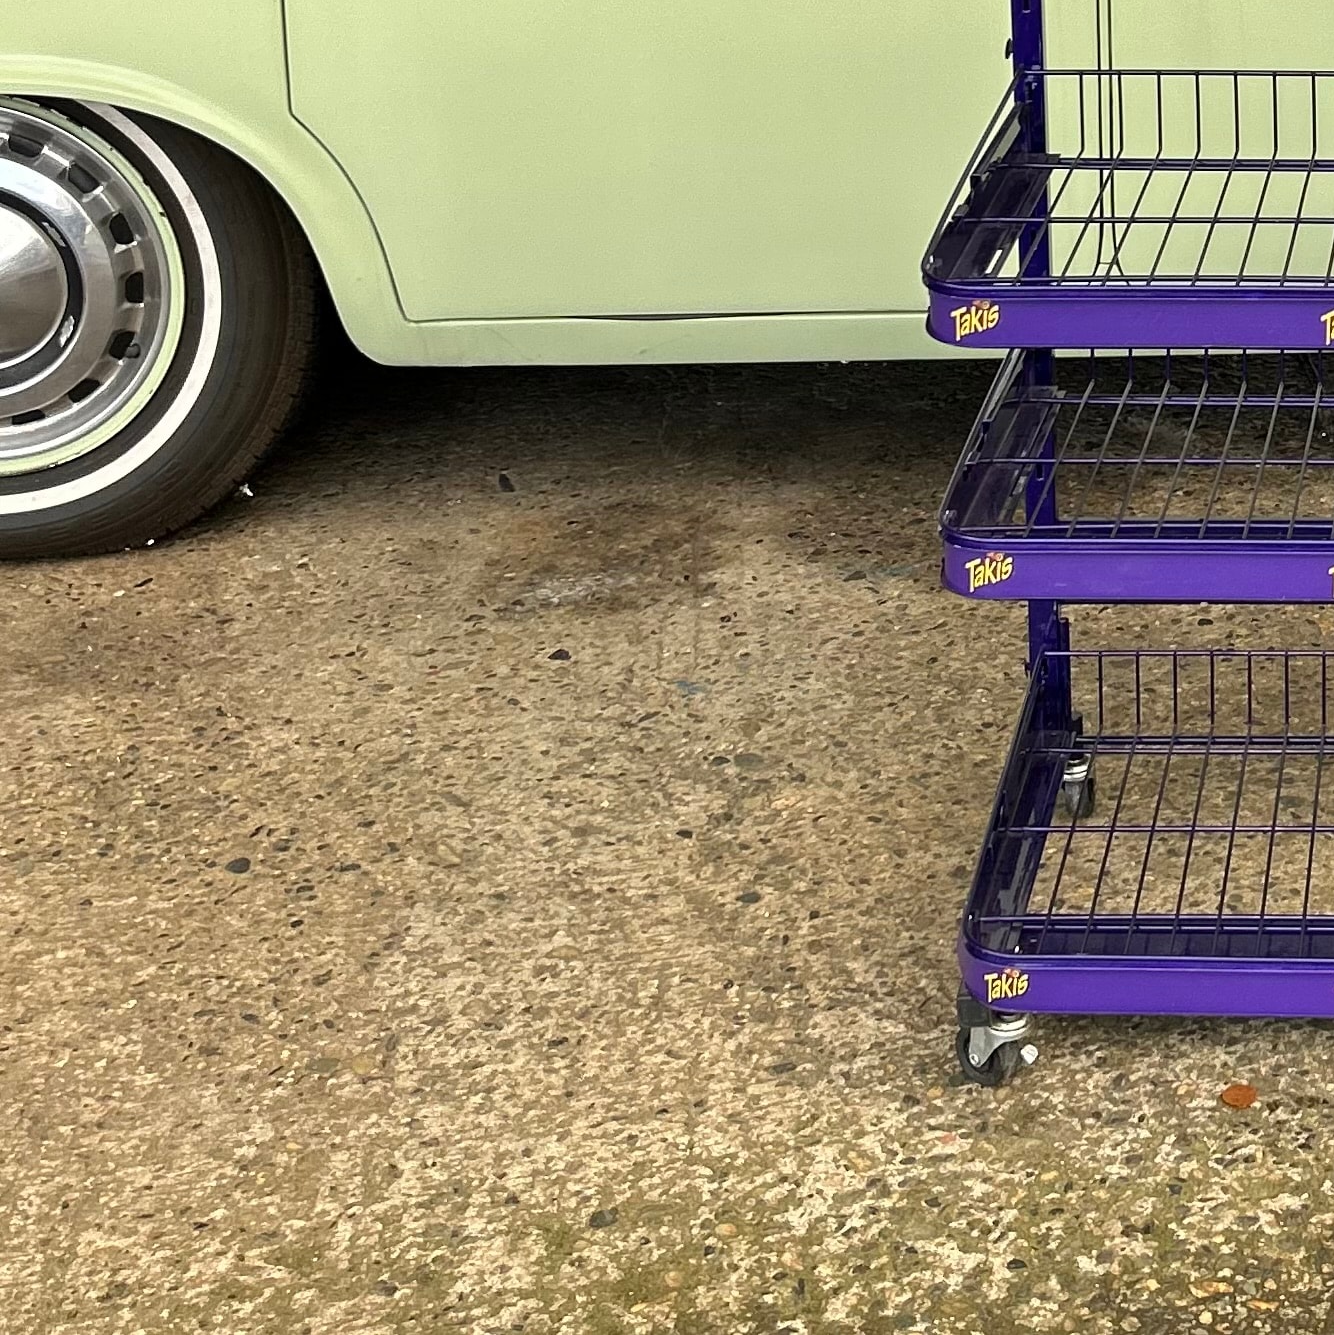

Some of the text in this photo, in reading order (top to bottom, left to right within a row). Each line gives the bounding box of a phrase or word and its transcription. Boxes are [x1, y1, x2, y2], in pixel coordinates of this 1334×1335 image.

[951, 302, 999, 342] Takis
[965, 554, 1013, 591] Takis
[984, 971, 1030, 1003] Takis
